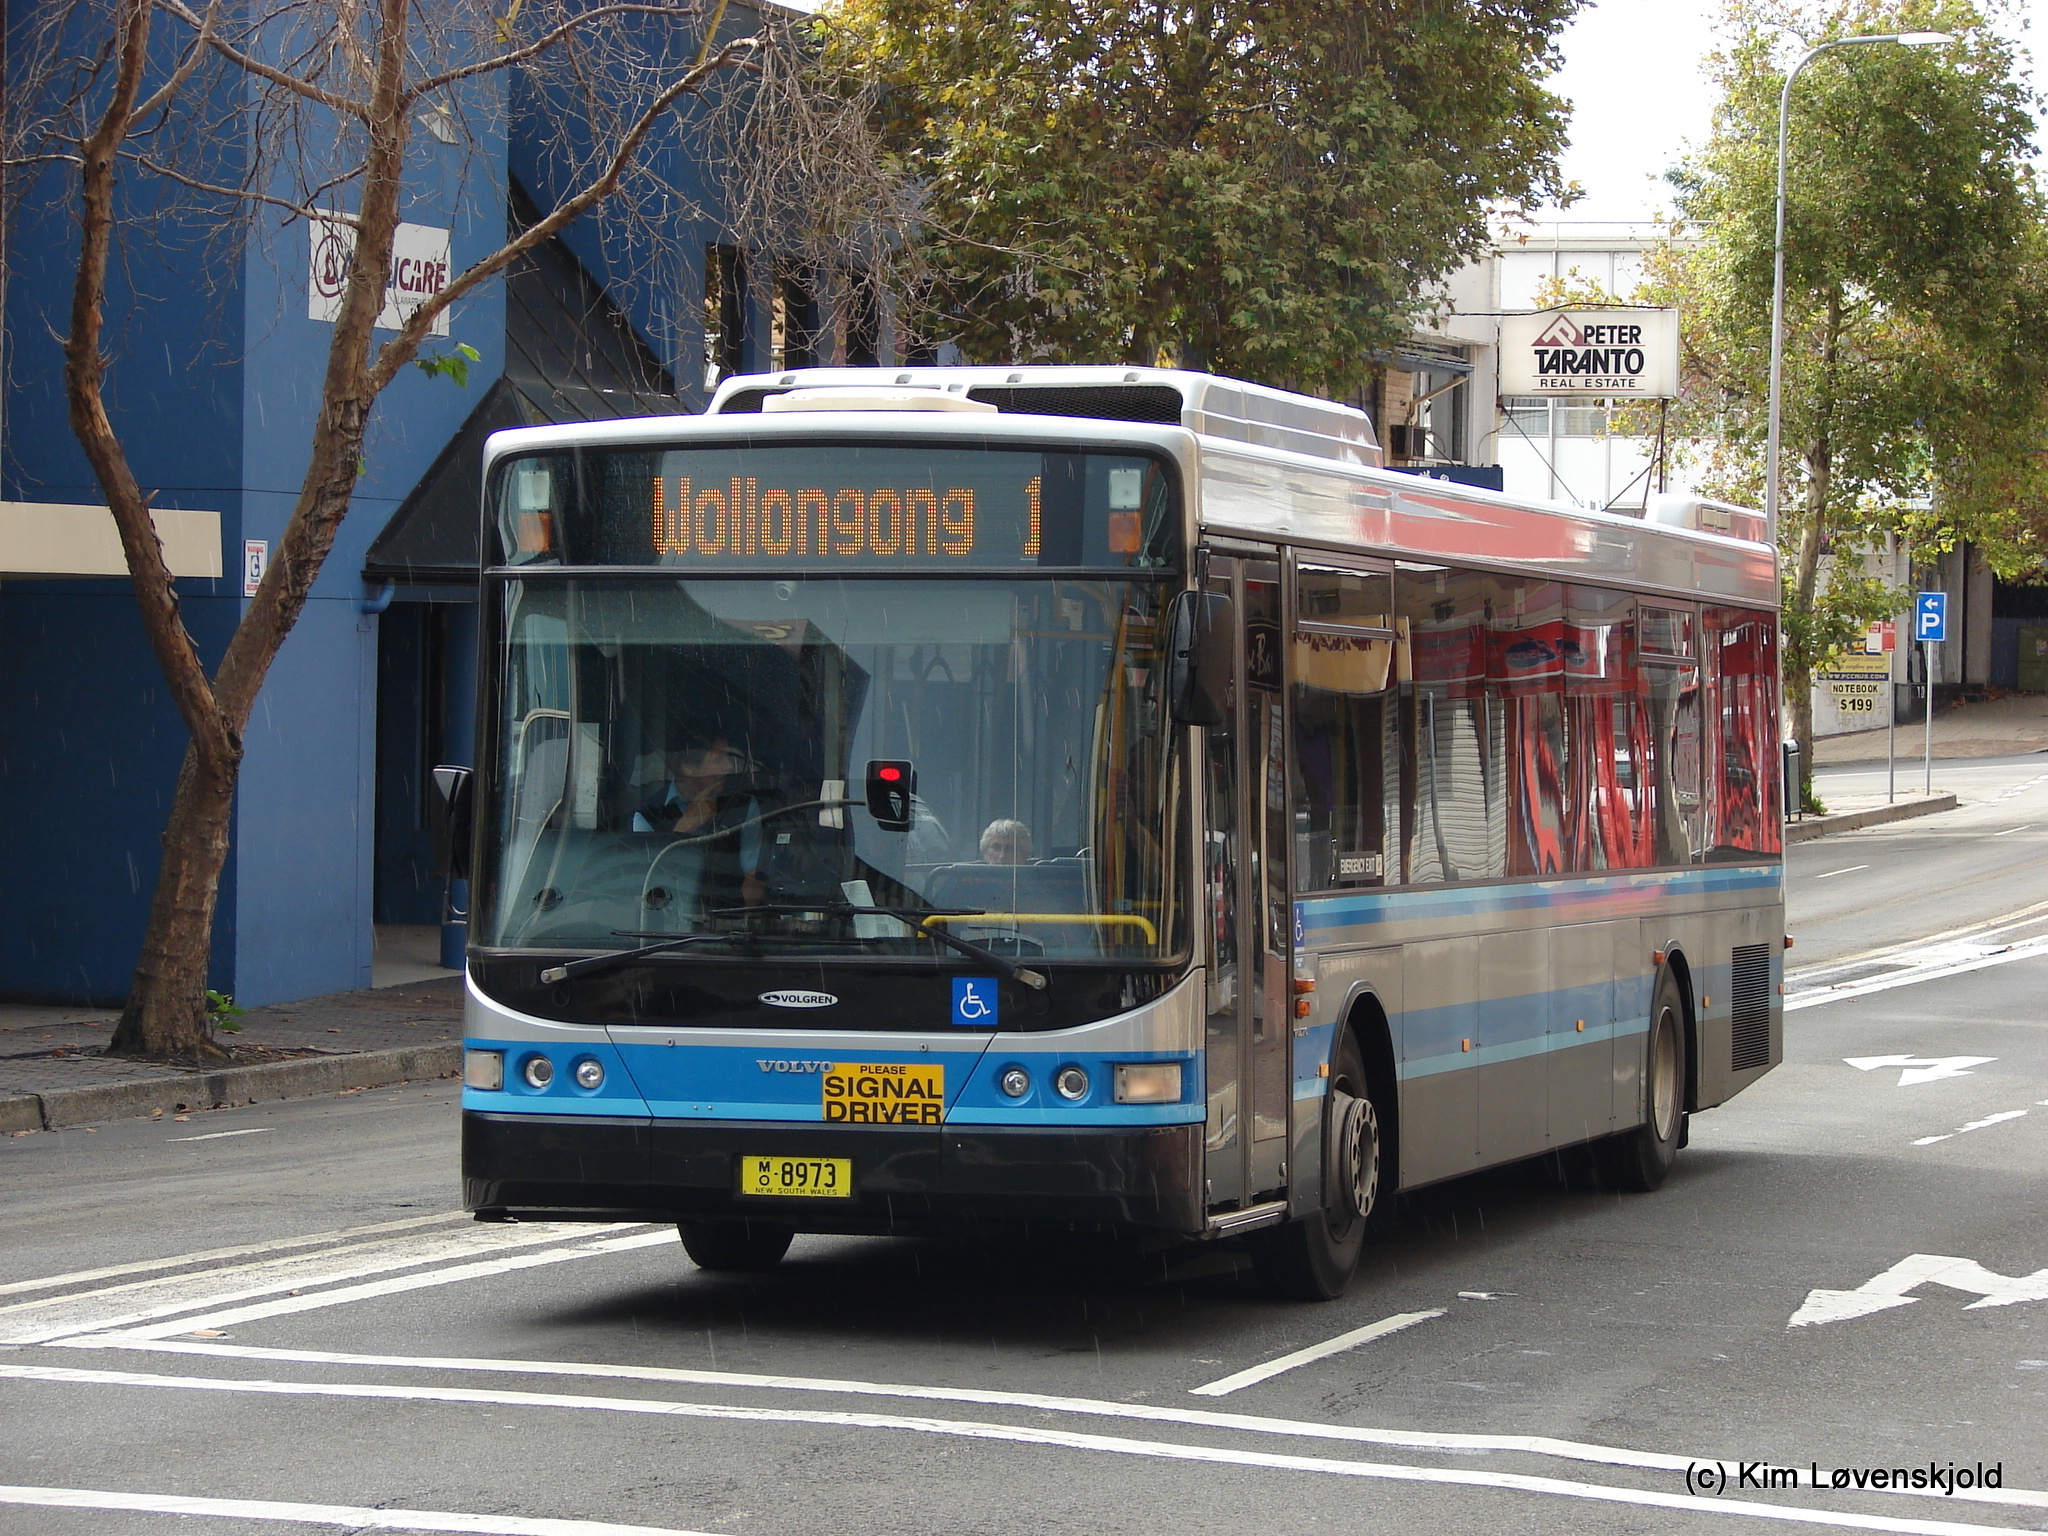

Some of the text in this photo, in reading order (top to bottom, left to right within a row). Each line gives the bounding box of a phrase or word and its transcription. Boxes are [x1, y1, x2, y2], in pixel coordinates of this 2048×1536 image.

[1583, 325, 1642, 344] PETER
[1534, 348, 1645, 375] TARANTO
[1540, 378, 1636, 388] REAL ESTATE
[652, 476, 1041, 555] Wollongong 1
[1921, 612, 1940, 635] P
[1832, 684, 1879, 693] NOTEBOOK
[1840, 698, 1873, 711] $199
[781, 994, 833, 1004] VOLGREN
[756, 1059, 835, 1073] VOLVO
[860, 1065, 907, 1075] PLEASE
[824, 1076, 943, 1099] SIGNAL
[826, 1101, 942, 1124] DRIVER
[811, 1188, 837, 1196] WALES
